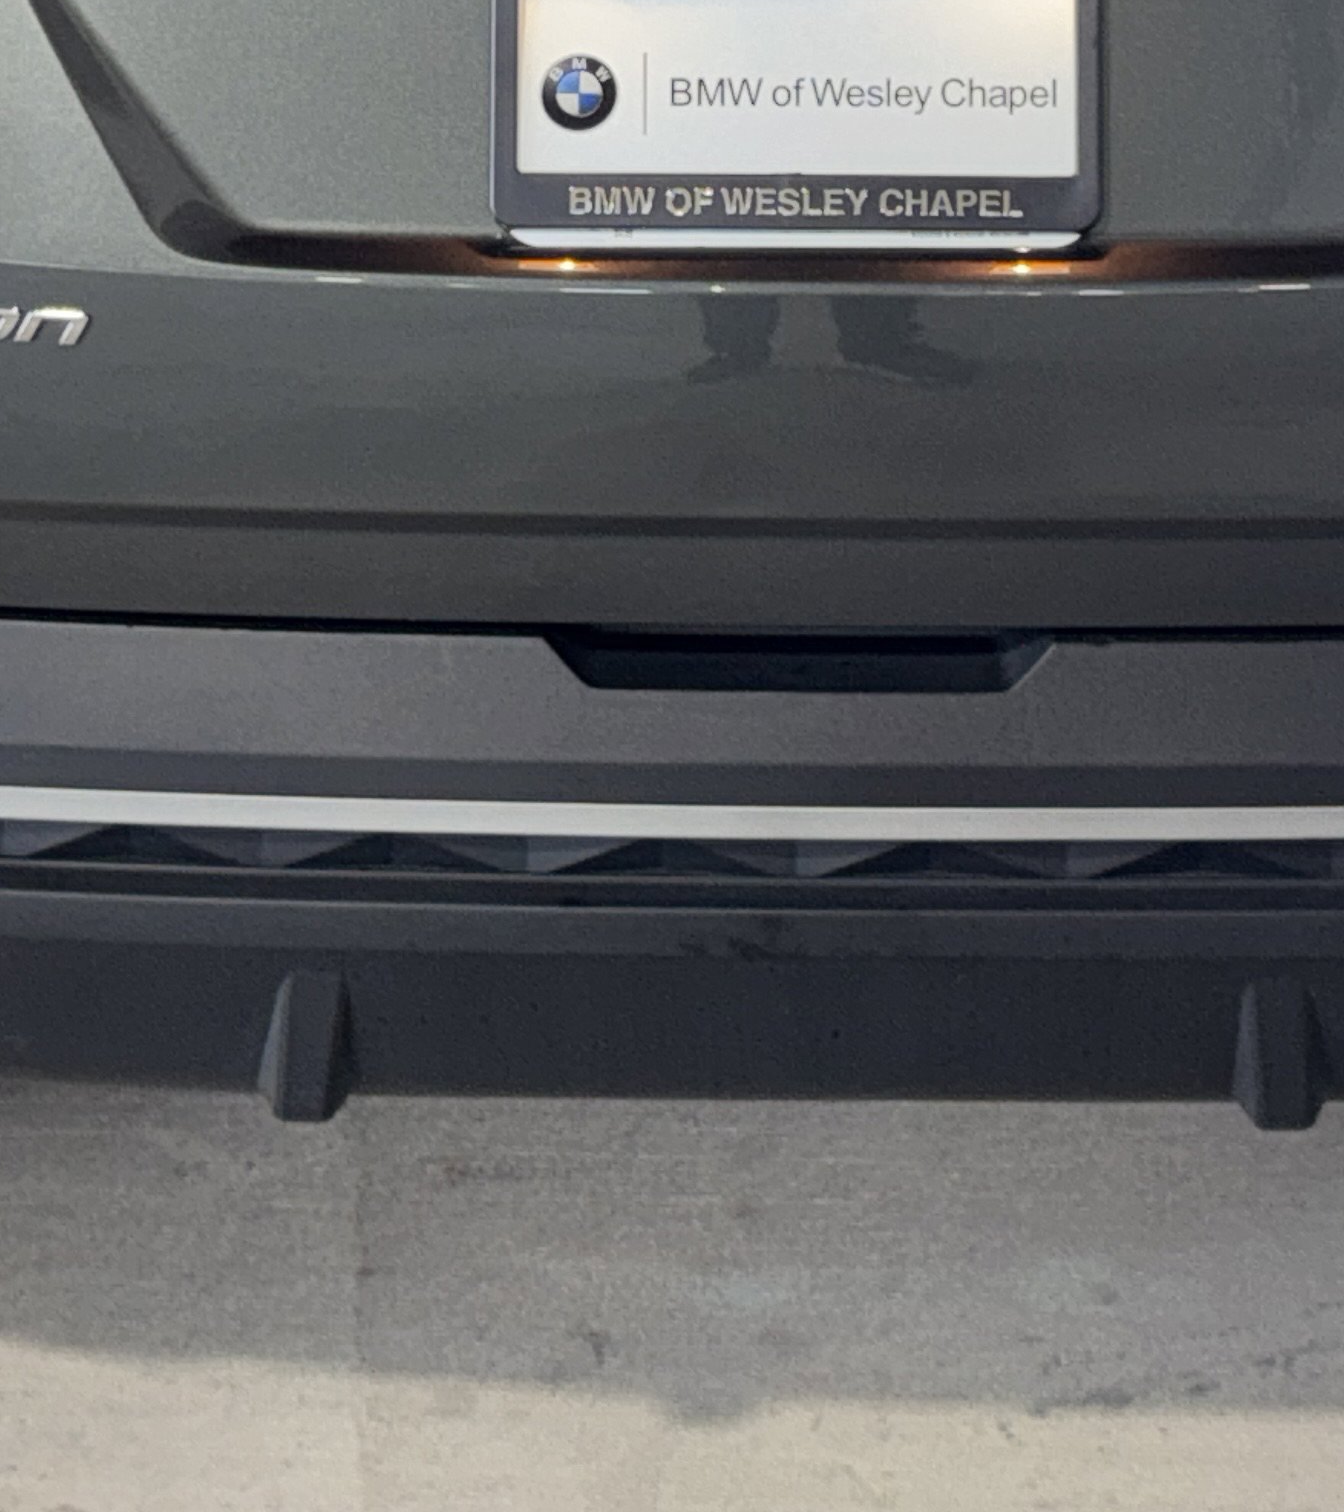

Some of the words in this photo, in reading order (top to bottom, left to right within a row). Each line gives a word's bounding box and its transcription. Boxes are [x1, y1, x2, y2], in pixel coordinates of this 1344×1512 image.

[548, 56, 613, 83] BMW
[669, 77, 764, 107] BMW
[771, 77, 807, 107] of
[811, 77, 932, 115] Wesley
[940, 77, 1059, 115] Chapel
[568, 186, 656, 217] BMW
[664, 186, 714, 217] OF
[720, 186, 868, 218] WESLEY
[879, 187, 1024, 219] CHAPEL
